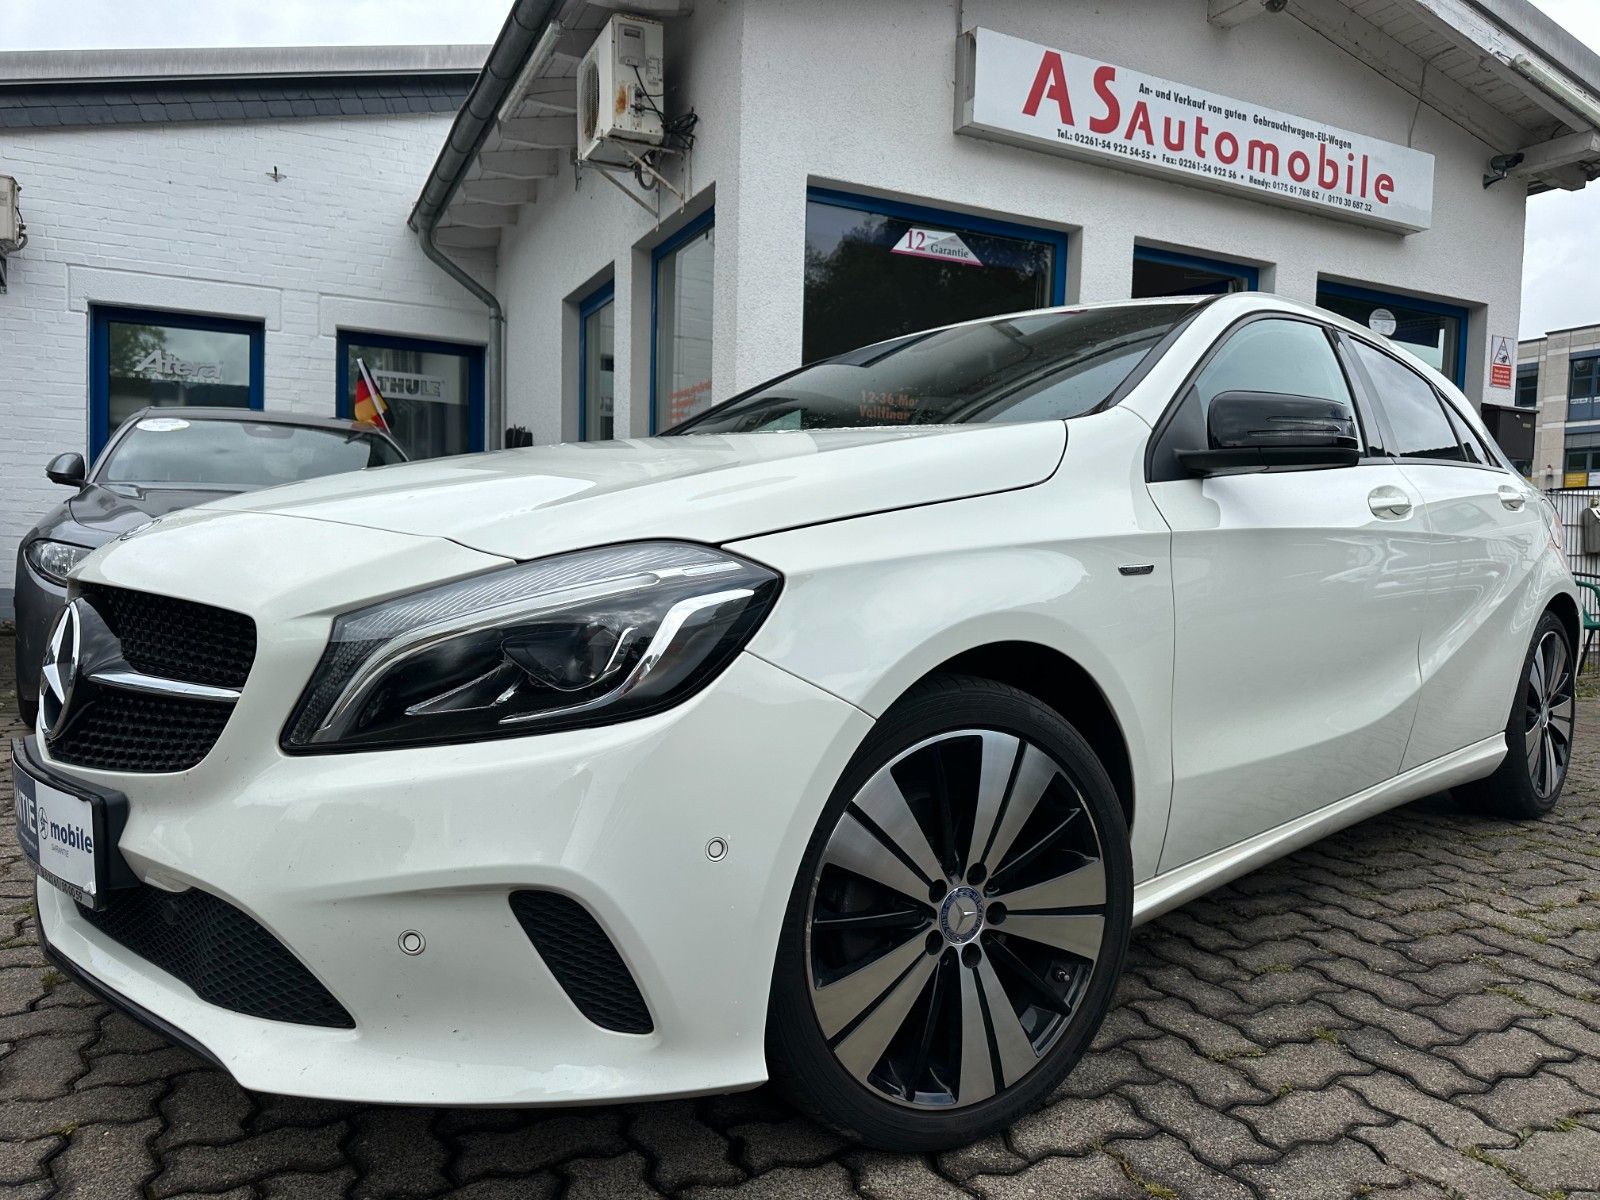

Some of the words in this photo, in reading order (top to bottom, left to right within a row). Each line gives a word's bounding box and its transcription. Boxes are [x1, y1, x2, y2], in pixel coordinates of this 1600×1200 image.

[1139, 83, 1153, 95] An-
[1155, 90, 1171, 101] und
[1173, 92, 1206, 110] Verkauf
[1207, 103, 1222, 115] von
[1224, 109, 1247, 121] guten
[1057, 128, 1073, 140] Tel.:
[1074, 133, 1111, 150] 02261-54
[1113, 143, 1128, 154] 922
[1129, 148, 1151, 160] 54-55
[1162, 154, 1177, 165] Fax:
[1178, 158, 1212, 173] 02261-54
[1213, 166, 1227, 177] 922
[1228, 171, 1237, 180] 56
[1272, 182, 1289, 193] 0175
[1289, 184, 1299, 195] 61
[1311, 189, 1321, 201] 62
[1327, 195, 1343, 206] 0170
[1364, 202, 1374, 214] 32
[905, 229, 926, 251] 12
[930, 243, 969, 259] Garantie
[376, 375, 441, 398] THULE
[50, 821, 93, 854] mobile
